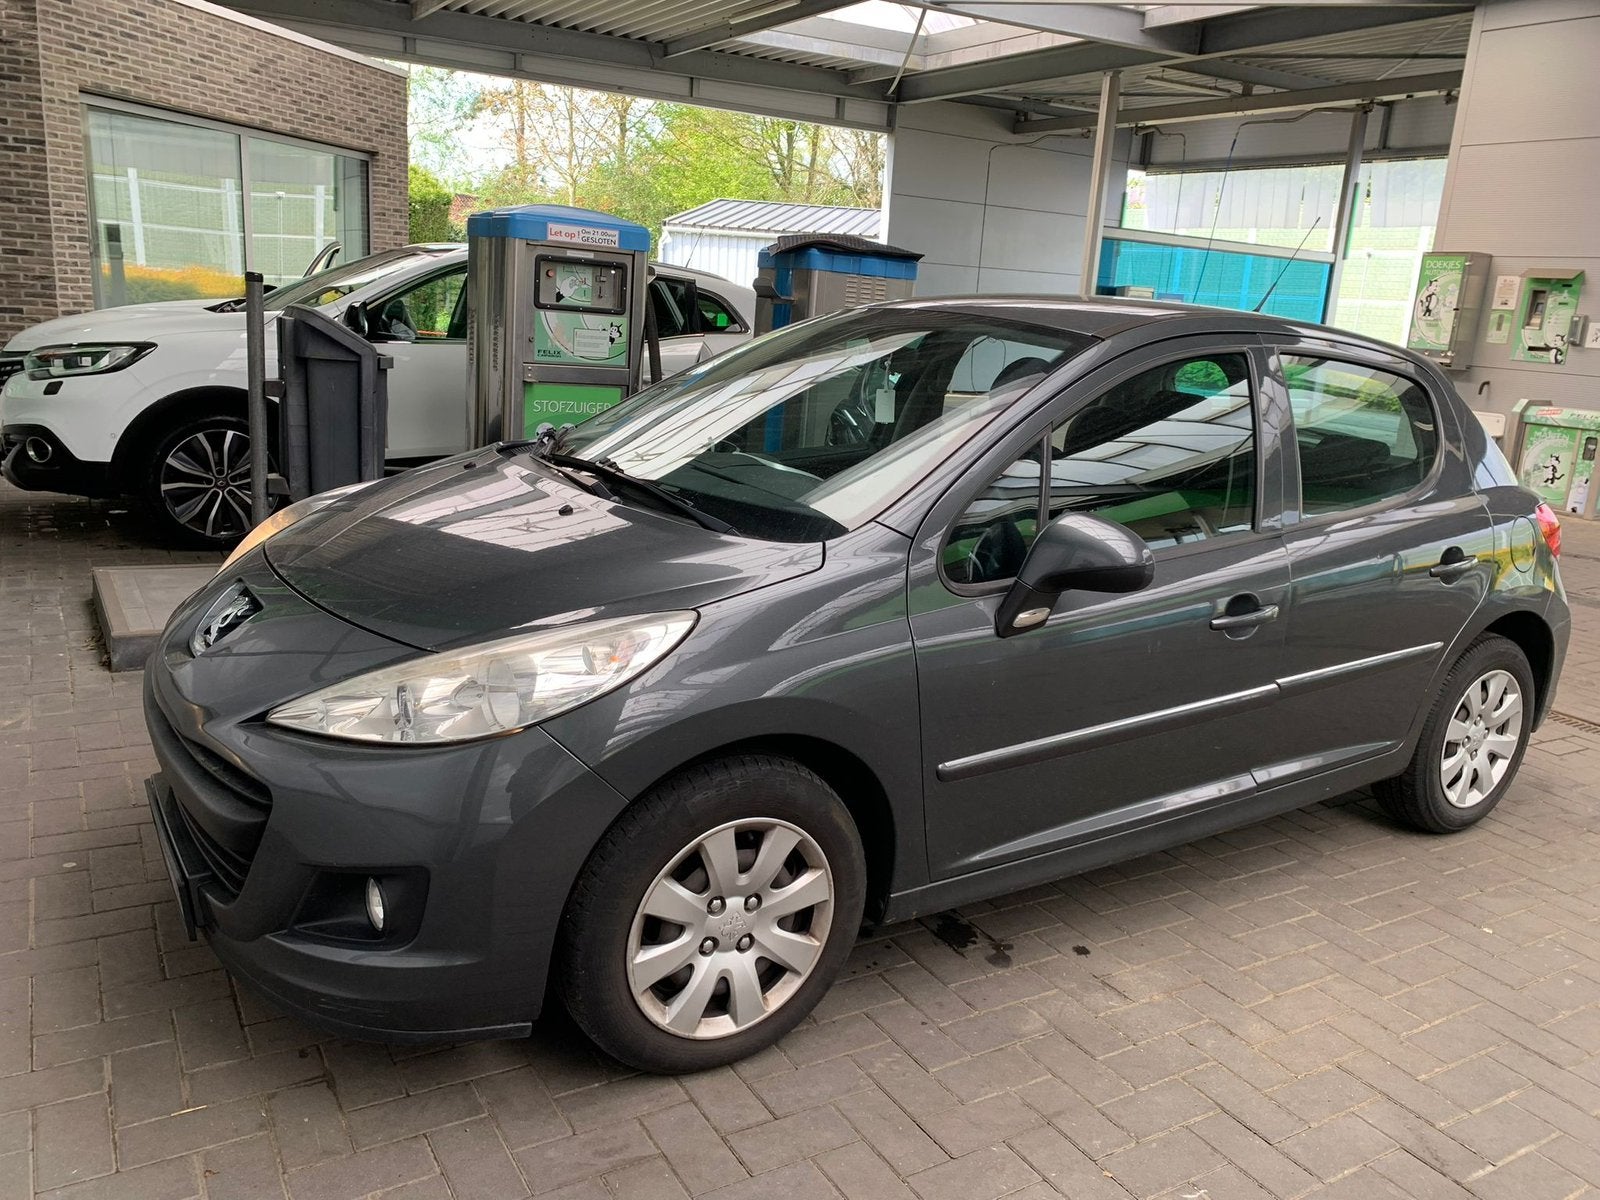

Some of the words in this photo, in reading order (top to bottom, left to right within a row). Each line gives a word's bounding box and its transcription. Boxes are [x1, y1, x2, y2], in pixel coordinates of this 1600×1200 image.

[549, 227, 562, 237] Let
[564, 231, 576, 240] op
[581, 228, 591, 236] Om
[581, 236, 617, 246] GESLOTEN
[1425, 260, 1462, 270] DOEKJES
